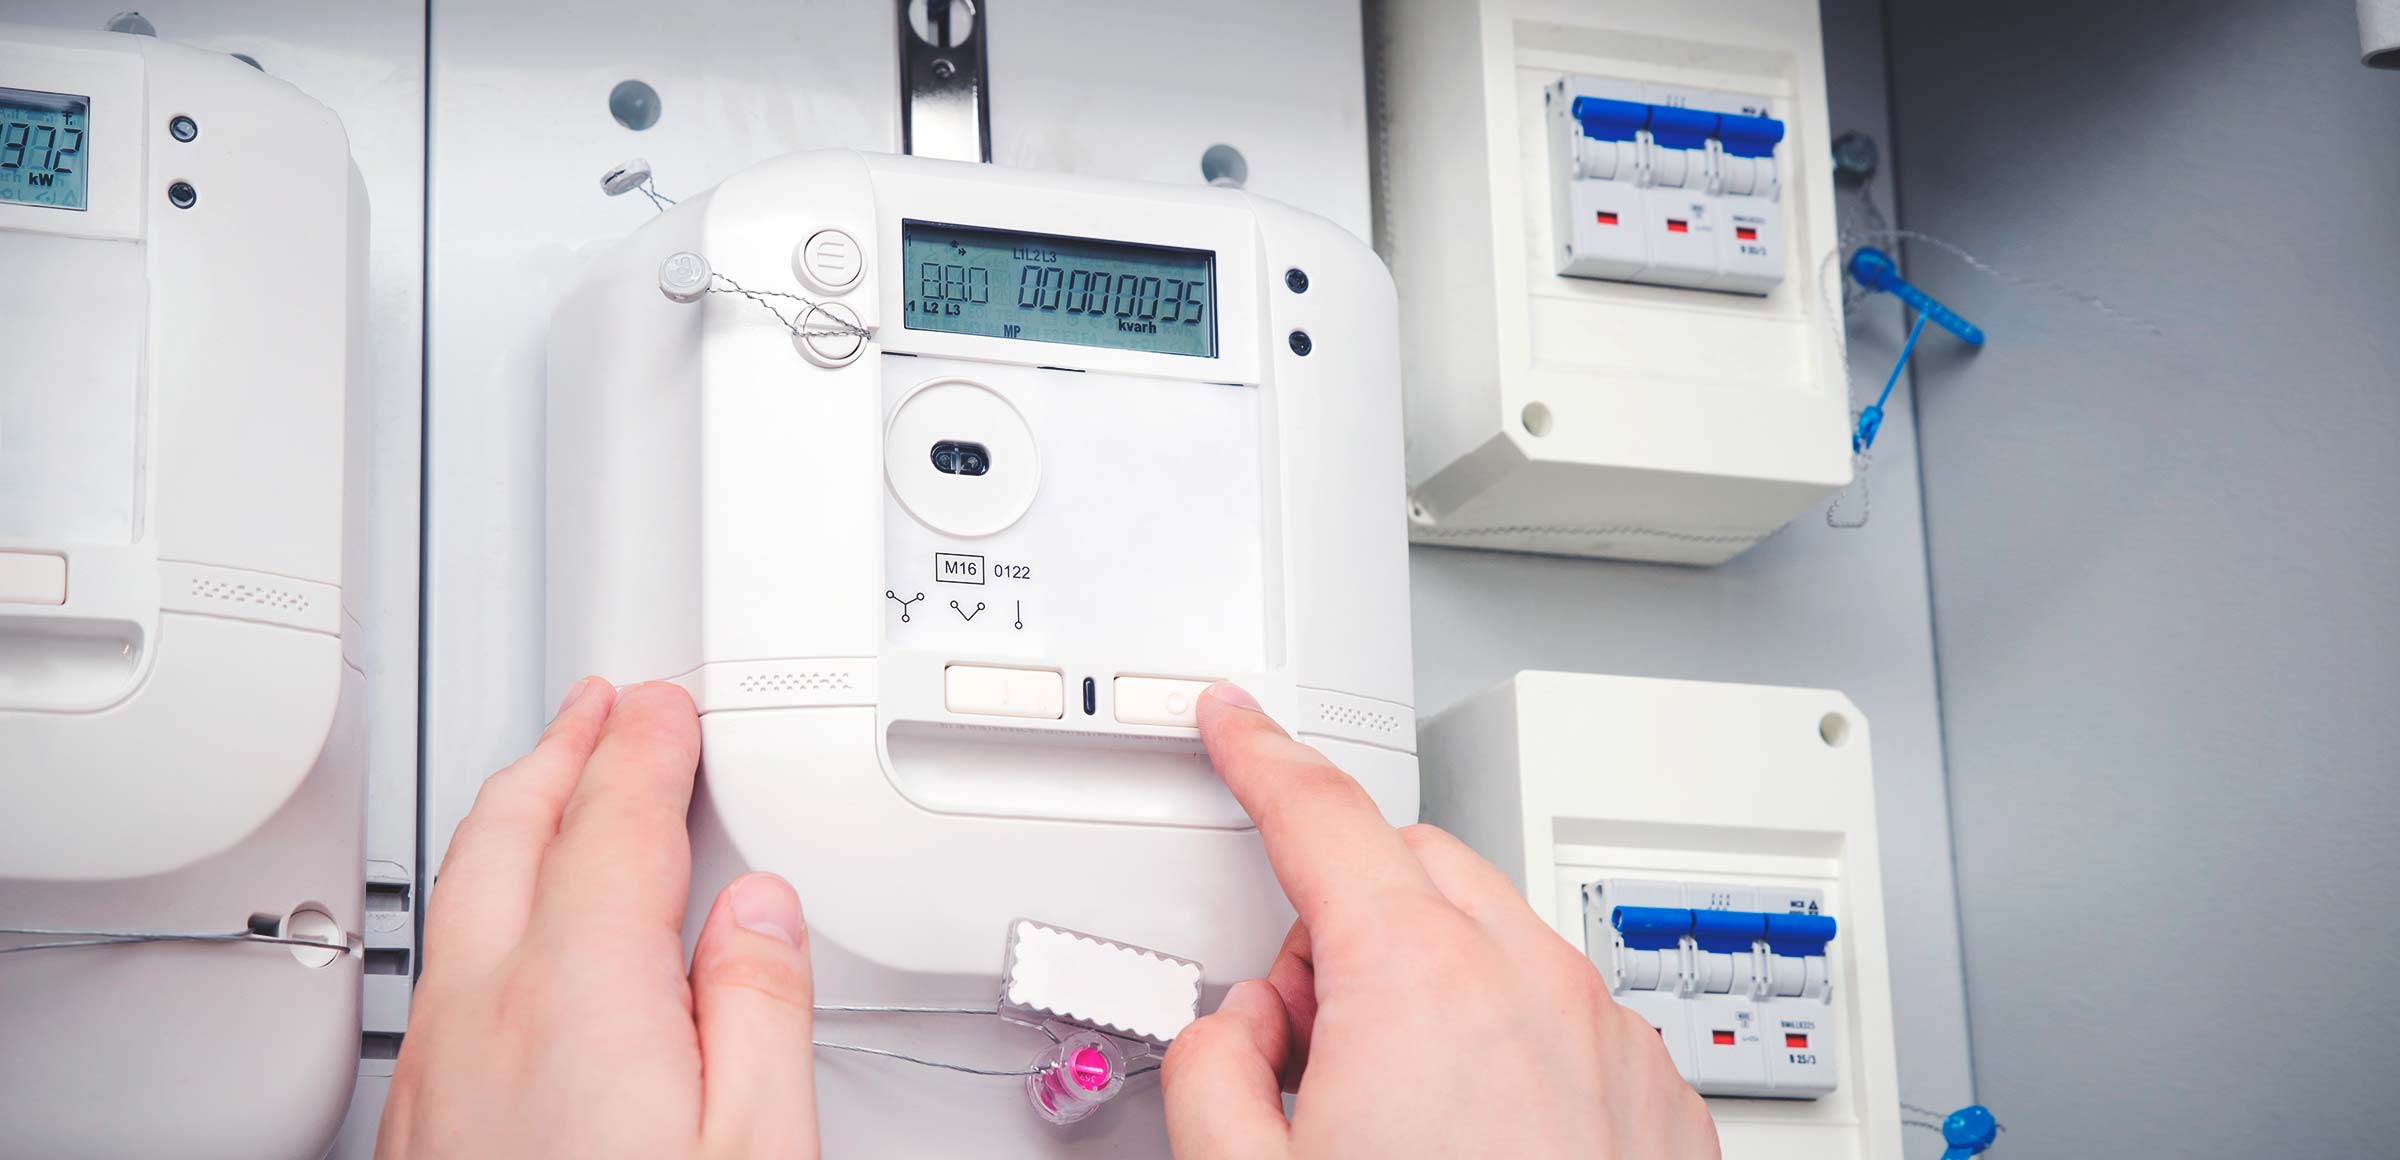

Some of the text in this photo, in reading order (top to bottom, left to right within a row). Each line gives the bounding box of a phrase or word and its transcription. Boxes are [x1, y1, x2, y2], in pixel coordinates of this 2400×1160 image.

[0, 122, 83, 174] 372
[28, 172, 54, 187] kW
[923, 301, 939, 314] L2
[945, 303, 961, 316] L3
[1003, 324, 1021, 338] MP
[1118, 319, 1157, 334] kvarh
[945, 560, 1031, 580] M16 0122
